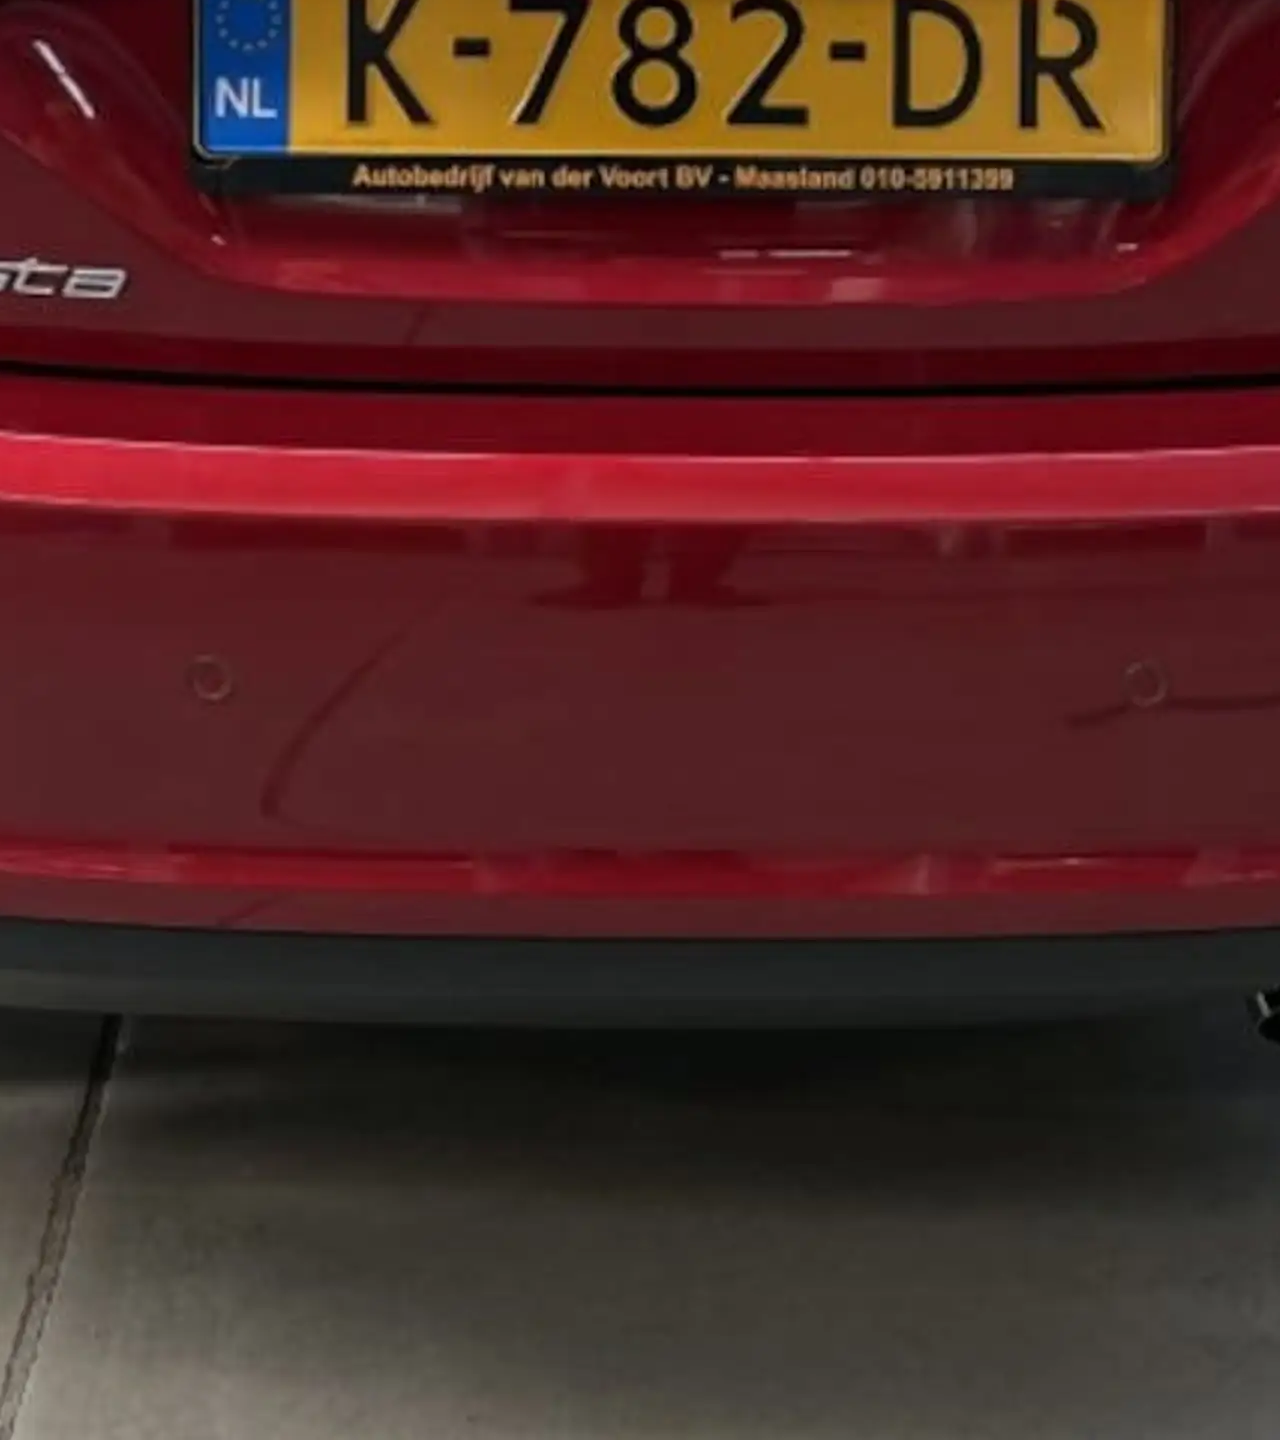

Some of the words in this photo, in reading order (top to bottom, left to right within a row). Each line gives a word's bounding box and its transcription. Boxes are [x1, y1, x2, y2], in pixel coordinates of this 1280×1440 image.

[215, 77, 278, 118] NL
[353, 164, 495, 193] Autobedrijf
[499, 168, 545, 187] van
[551, 164, 592, 187] der
[598, 165, 669, 188] Voort
[675, 165, 714, 188] BV
[734, 165, 855, 190] Maasland
